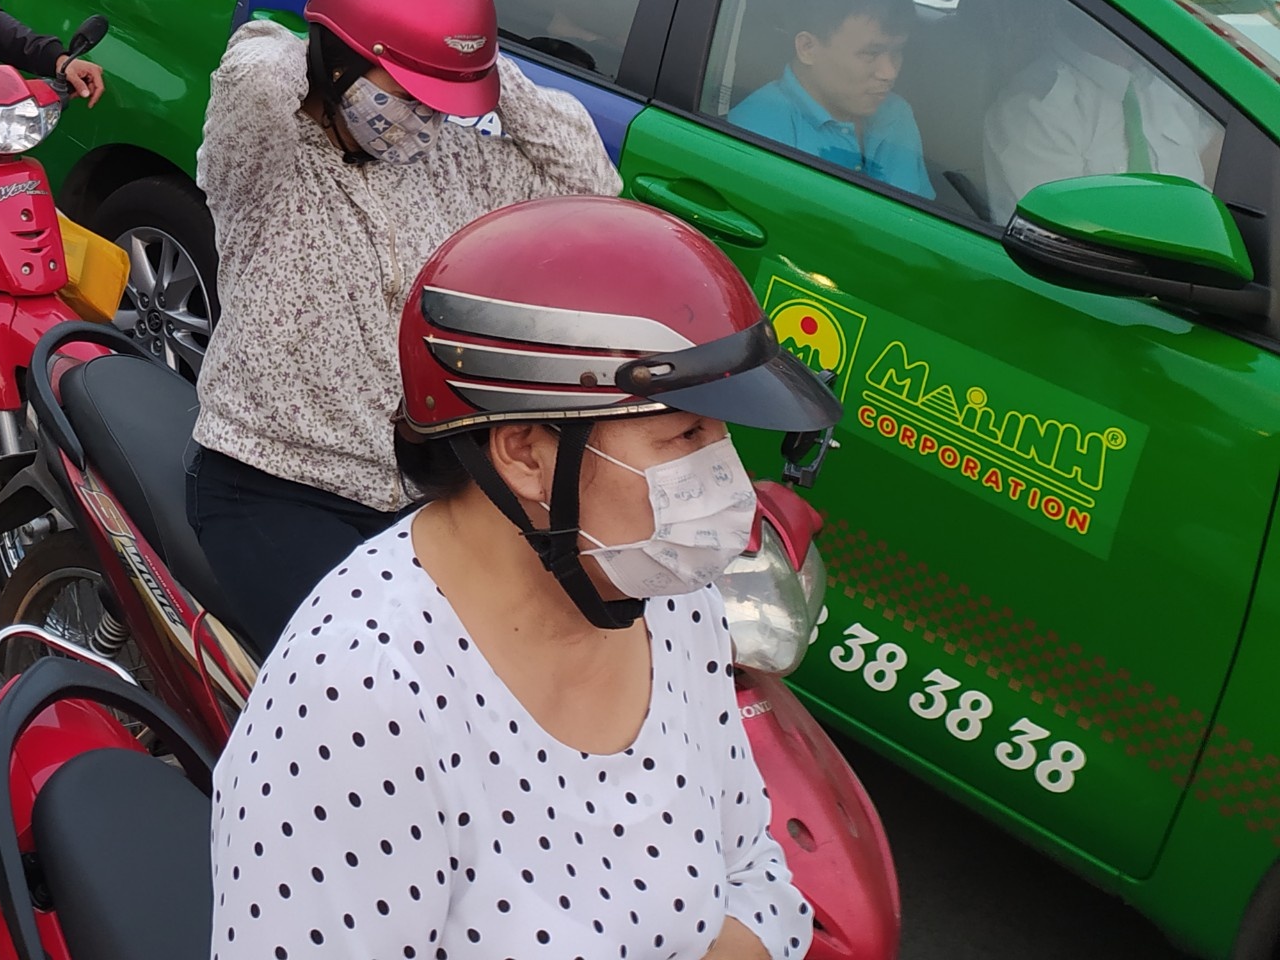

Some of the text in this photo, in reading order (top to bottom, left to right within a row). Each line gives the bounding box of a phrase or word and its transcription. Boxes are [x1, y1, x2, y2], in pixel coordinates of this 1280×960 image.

[858, 404, 1091, 535] CORPORATION
[739, 700, 772, 720] OND
[829, 622, 908, 692] 38
[909, 668, 994, 742] 38
[994, 717, 1087, 794] 38
